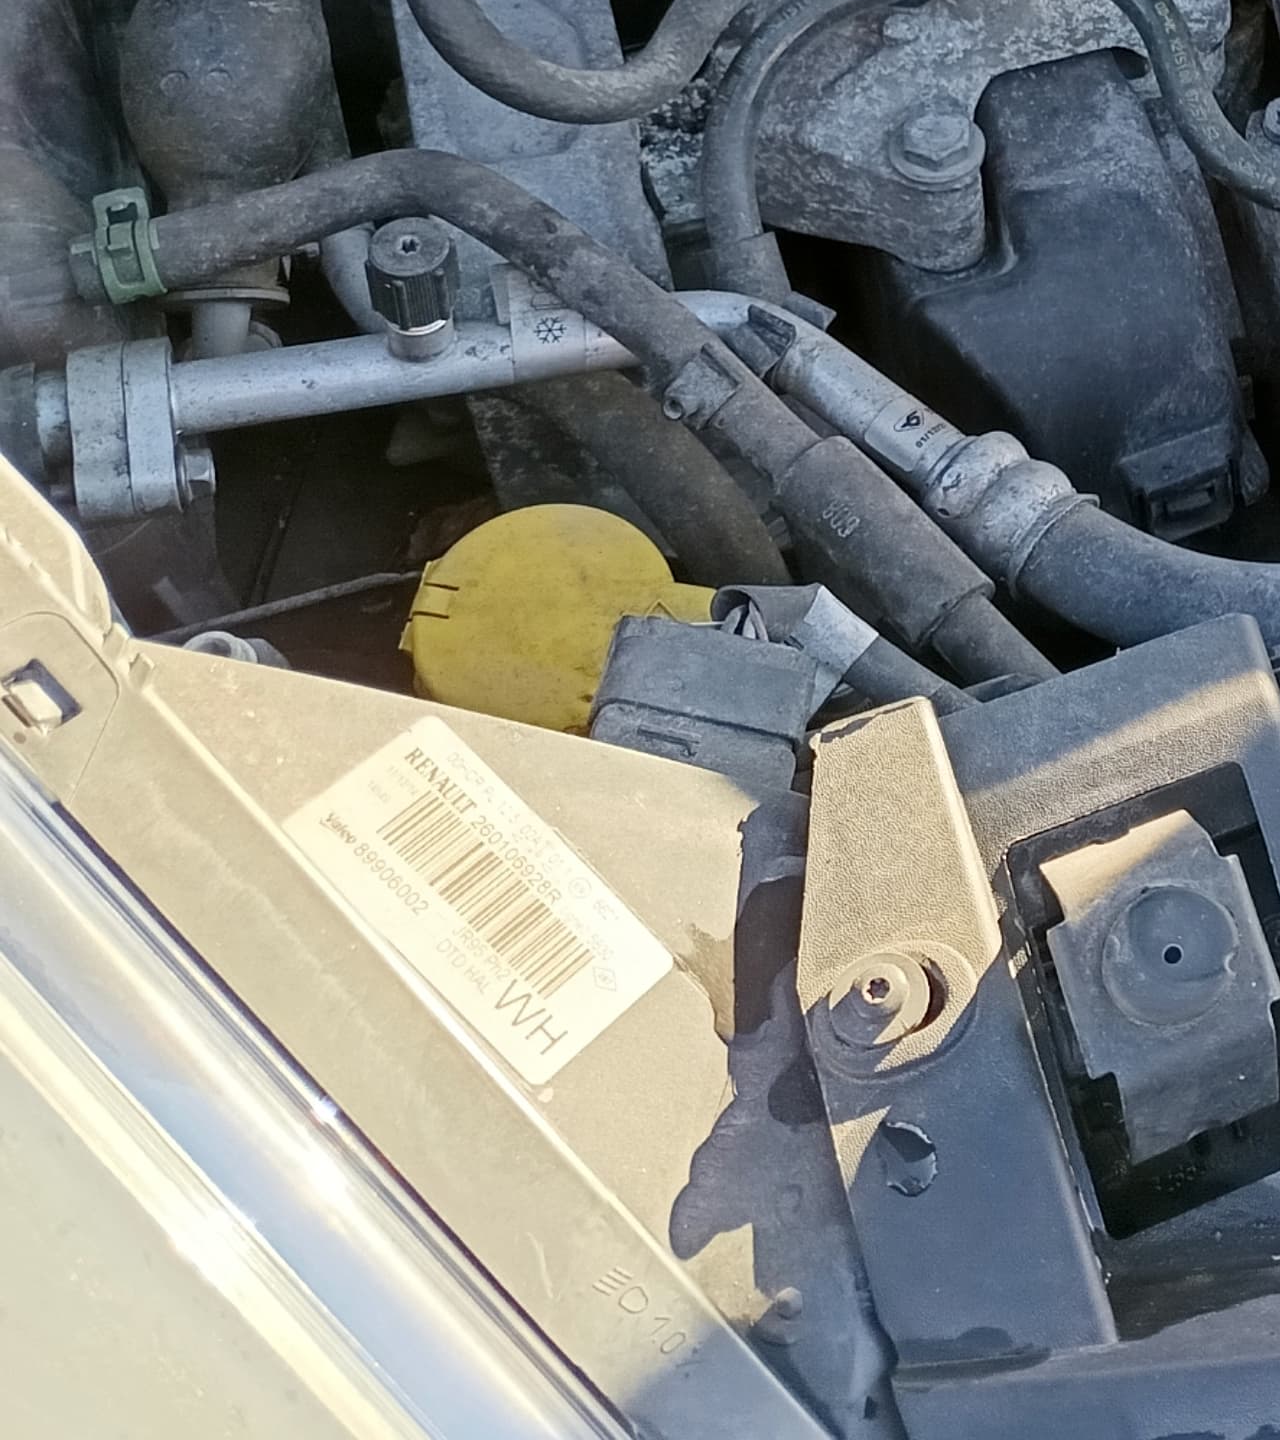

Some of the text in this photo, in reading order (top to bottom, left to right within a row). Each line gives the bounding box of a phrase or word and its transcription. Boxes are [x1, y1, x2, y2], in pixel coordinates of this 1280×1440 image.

[404, 747, 476, 813] RENAULT
[469, 815, 561, 904] 260106928R
[353, 842, 429, 915] 89906002
[493, 978, 568, 1055] WH
